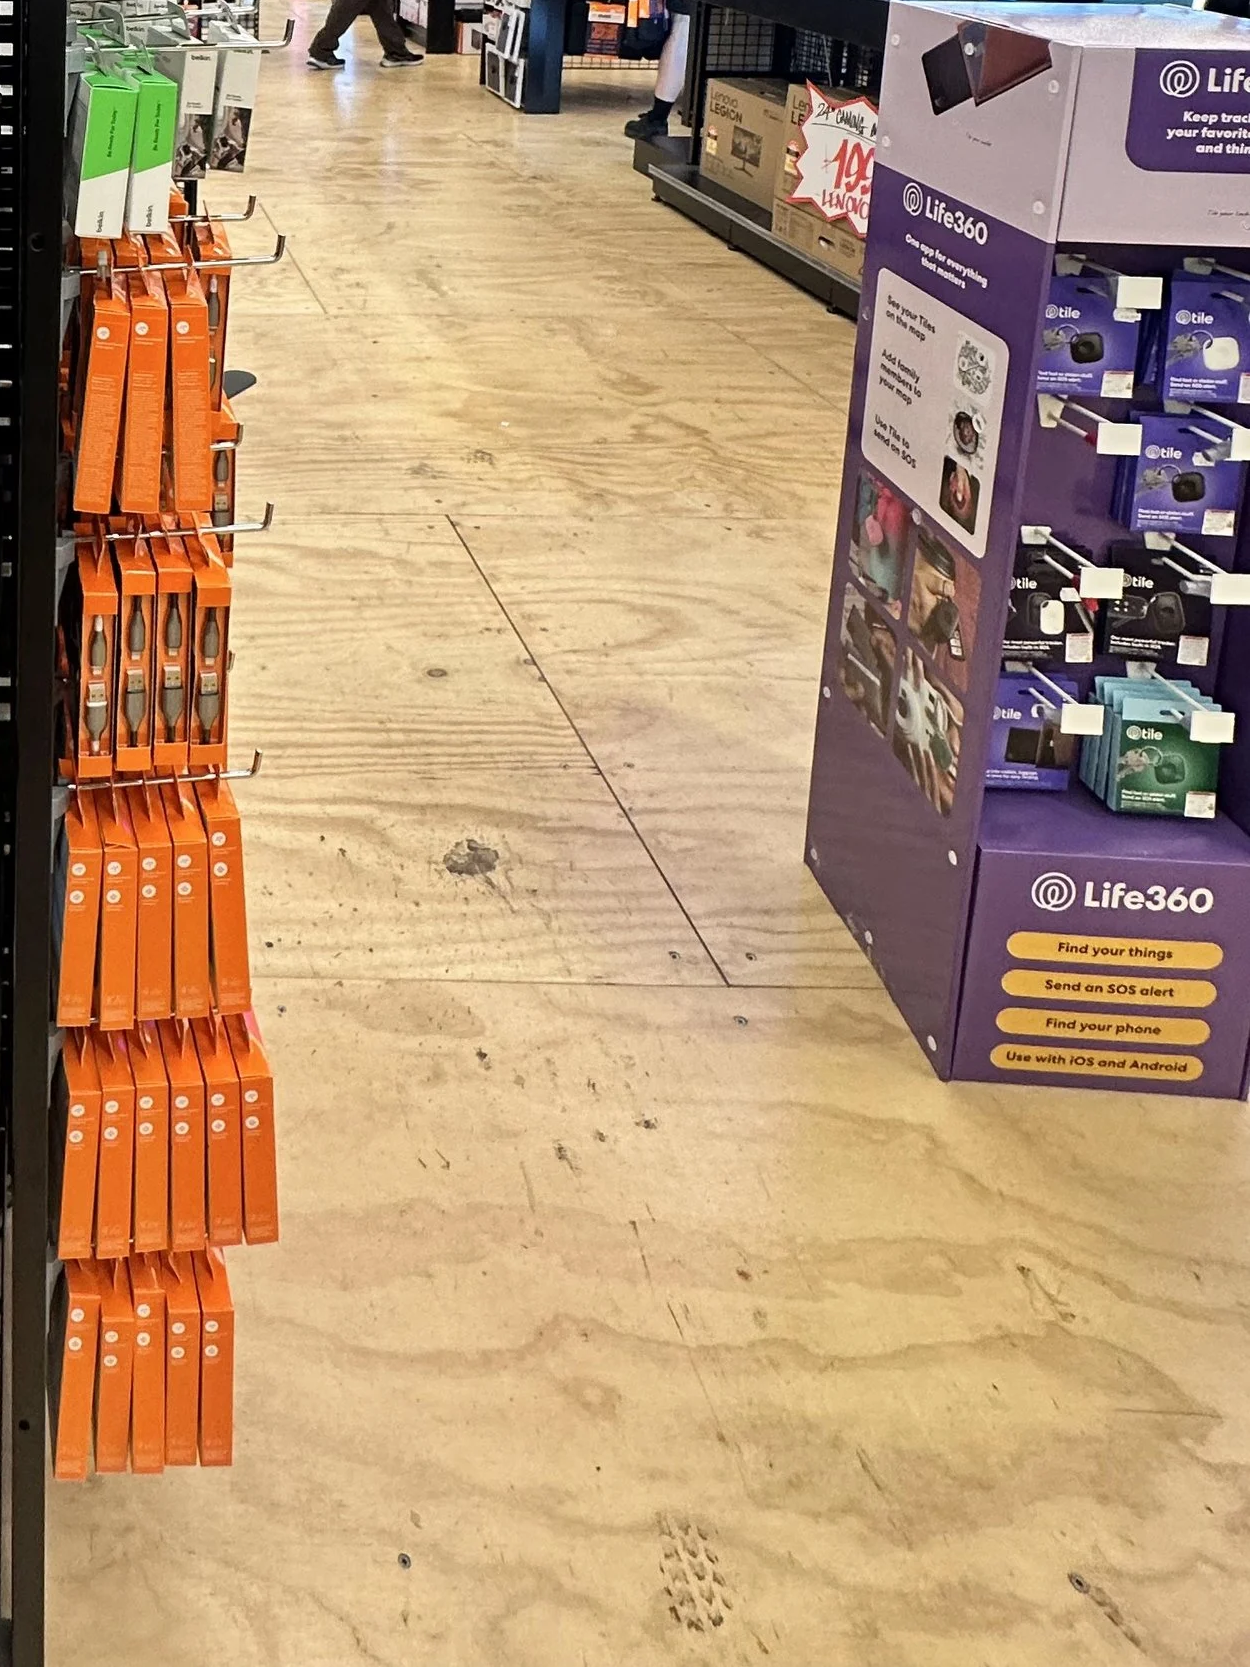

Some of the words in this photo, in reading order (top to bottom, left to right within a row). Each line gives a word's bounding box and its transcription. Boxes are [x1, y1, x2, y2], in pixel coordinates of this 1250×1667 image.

[709, 101, 743, 124] LEGION
[1183, 111, 1219, 125] Keep
[1167, 127, 1199, 139] your
[1196, 143, 1223, 154] and
[925, 195, 988, 245] Life360
[937, 264, 966, 289] matters
[945, 253, 988, 288] everything
[1058, 306, 1081, 319] tile
[1191, 312, 1214, 325] tile
[1160, 447, 1183, 459] tile
[1084, 881, 1215, 914] Life360
[1057, 942, 1089, 955] Find
[1092, 946, 1124, 959] your
[1128, 946, 1173, 962] things
[1045, 979, 1081, 992] Send
[1084, 984, 1104, 994] an
[1106, 984, 1137, 996] SOS
[1140, 986, 1175, 998] alert
[1046, 1018, 1076, 1030] Find
[1080, 1021, 1113, 1034] your
[1115, 1022, 1162, 1036] phone
[1006, 1050, 1032, 1062] Use
[1035, 1052, 1066, 1065] with
[1069, 1055, 1094, 1067] iOS
[1097, 1057, 1126, 1070] and
[1129, 1059, 1188, 1073] Android
